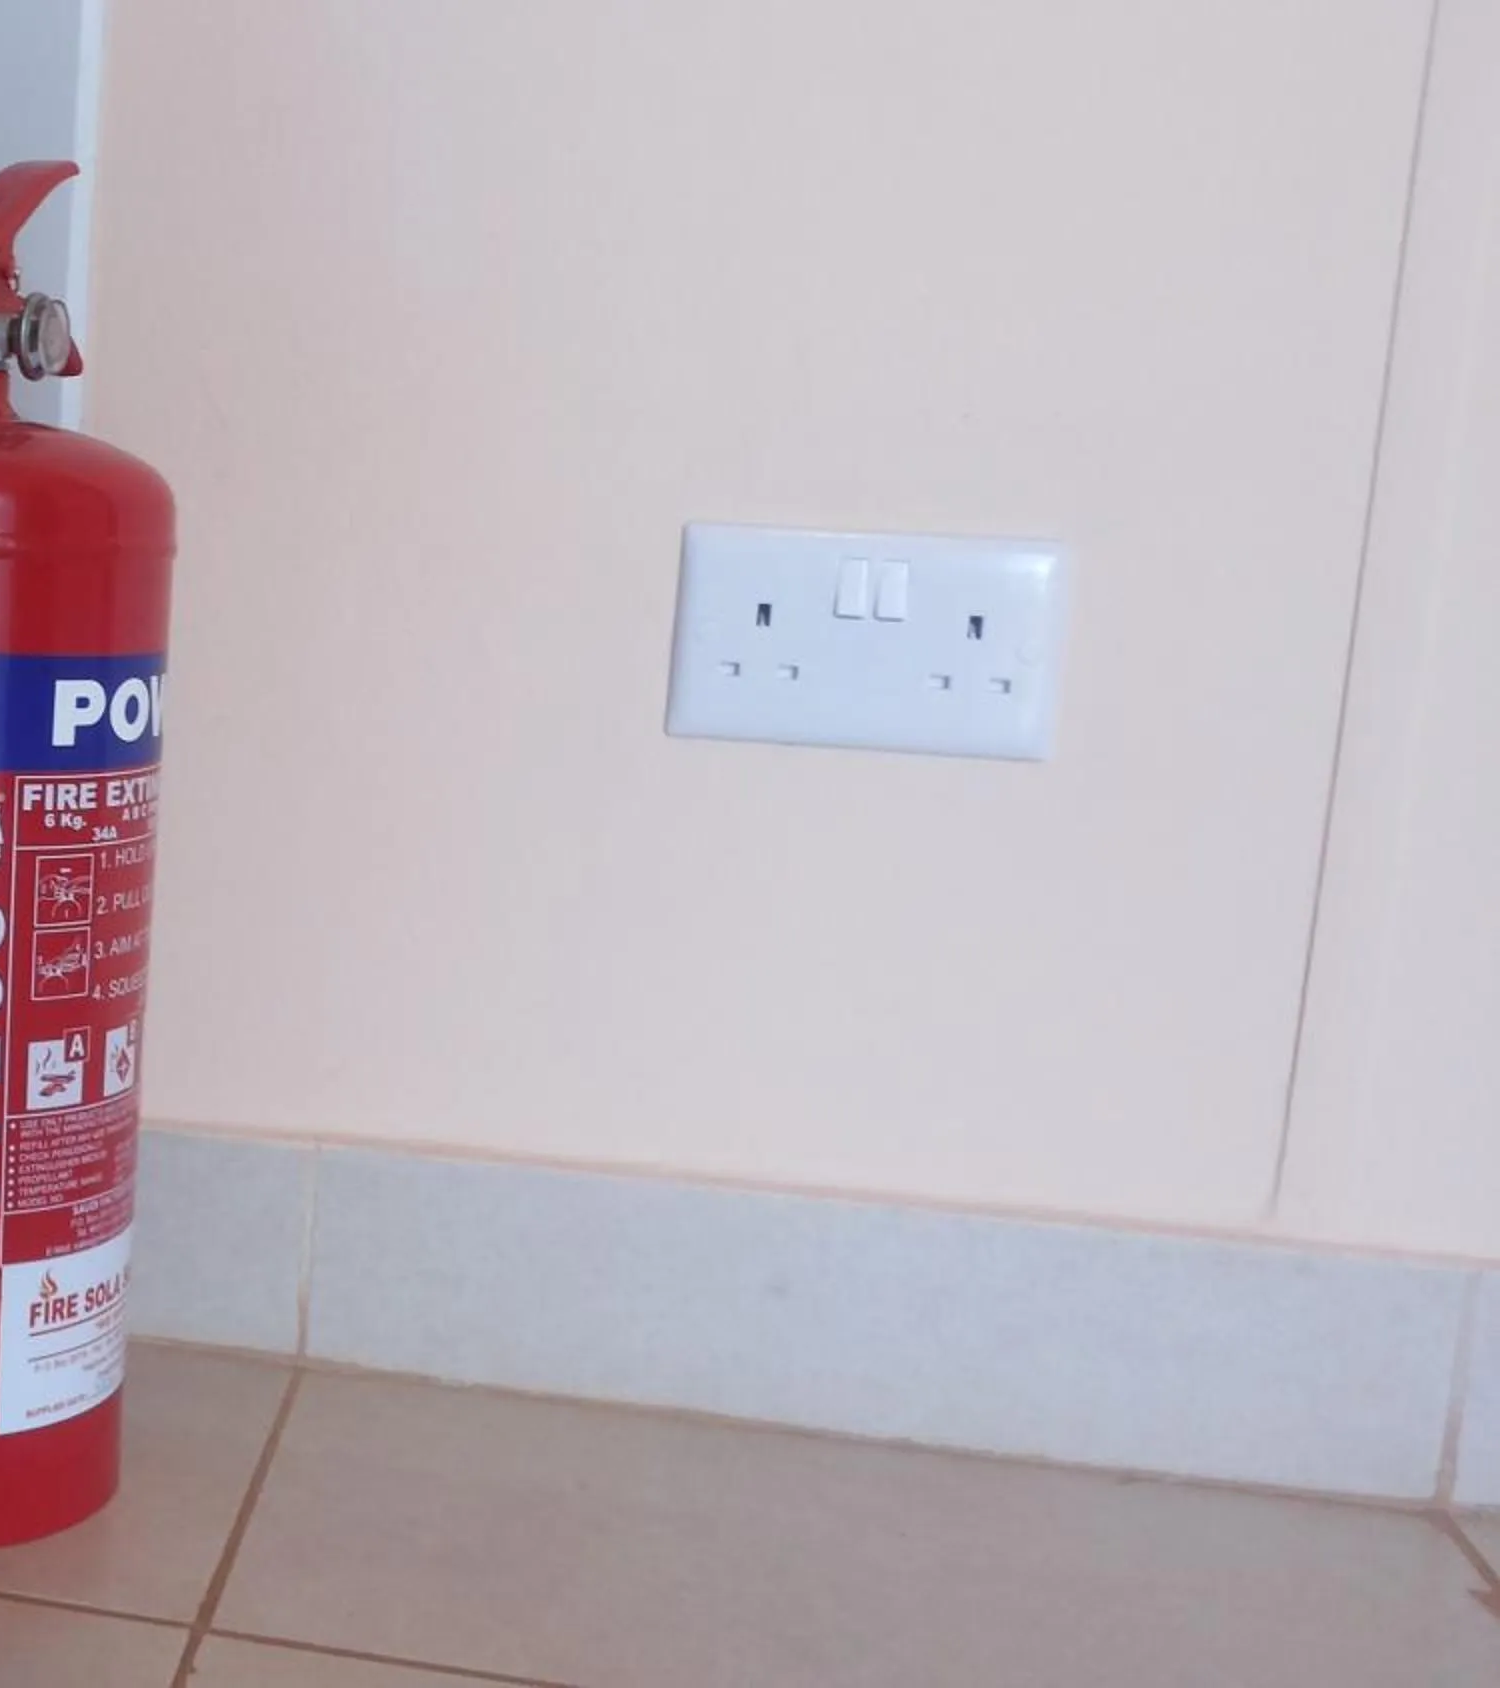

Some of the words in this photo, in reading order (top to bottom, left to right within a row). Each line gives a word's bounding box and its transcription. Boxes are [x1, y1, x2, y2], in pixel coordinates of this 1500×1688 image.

[22, 782, 98, 811] FIRE
[44, 813, 56, 828] 6
[60, 812, 87, 831] Kg.
[91, 825, 118, 842] 34A
[68, 1032, 86, 1059] A
[29, 1292, 79, 1329] FIRE
